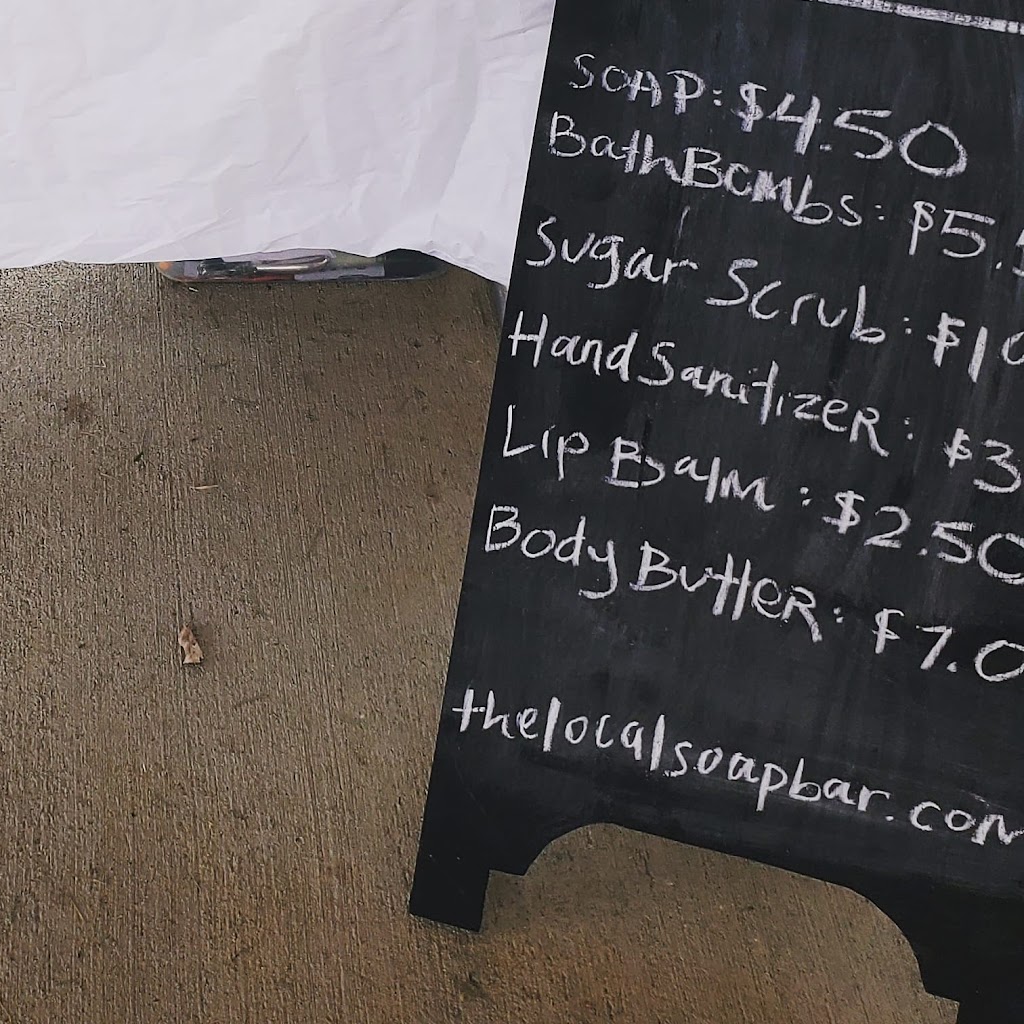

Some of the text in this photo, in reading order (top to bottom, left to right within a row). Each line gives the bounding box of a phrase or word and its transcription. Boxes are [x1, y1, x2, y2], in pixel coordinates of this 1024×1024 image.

[731, 81, 968, 177] $4.50
[525, 216, 700, 289] Sugar
[909, 199, 1024, 276] $5.
[502, 404, 591, 481] Lip
[822, 490, 1024, 586] $2.50
[942, 428, 1023, 494] $3
[484, 504, 620, 600] Body
[872, 608, 1024, 683] $7.0
